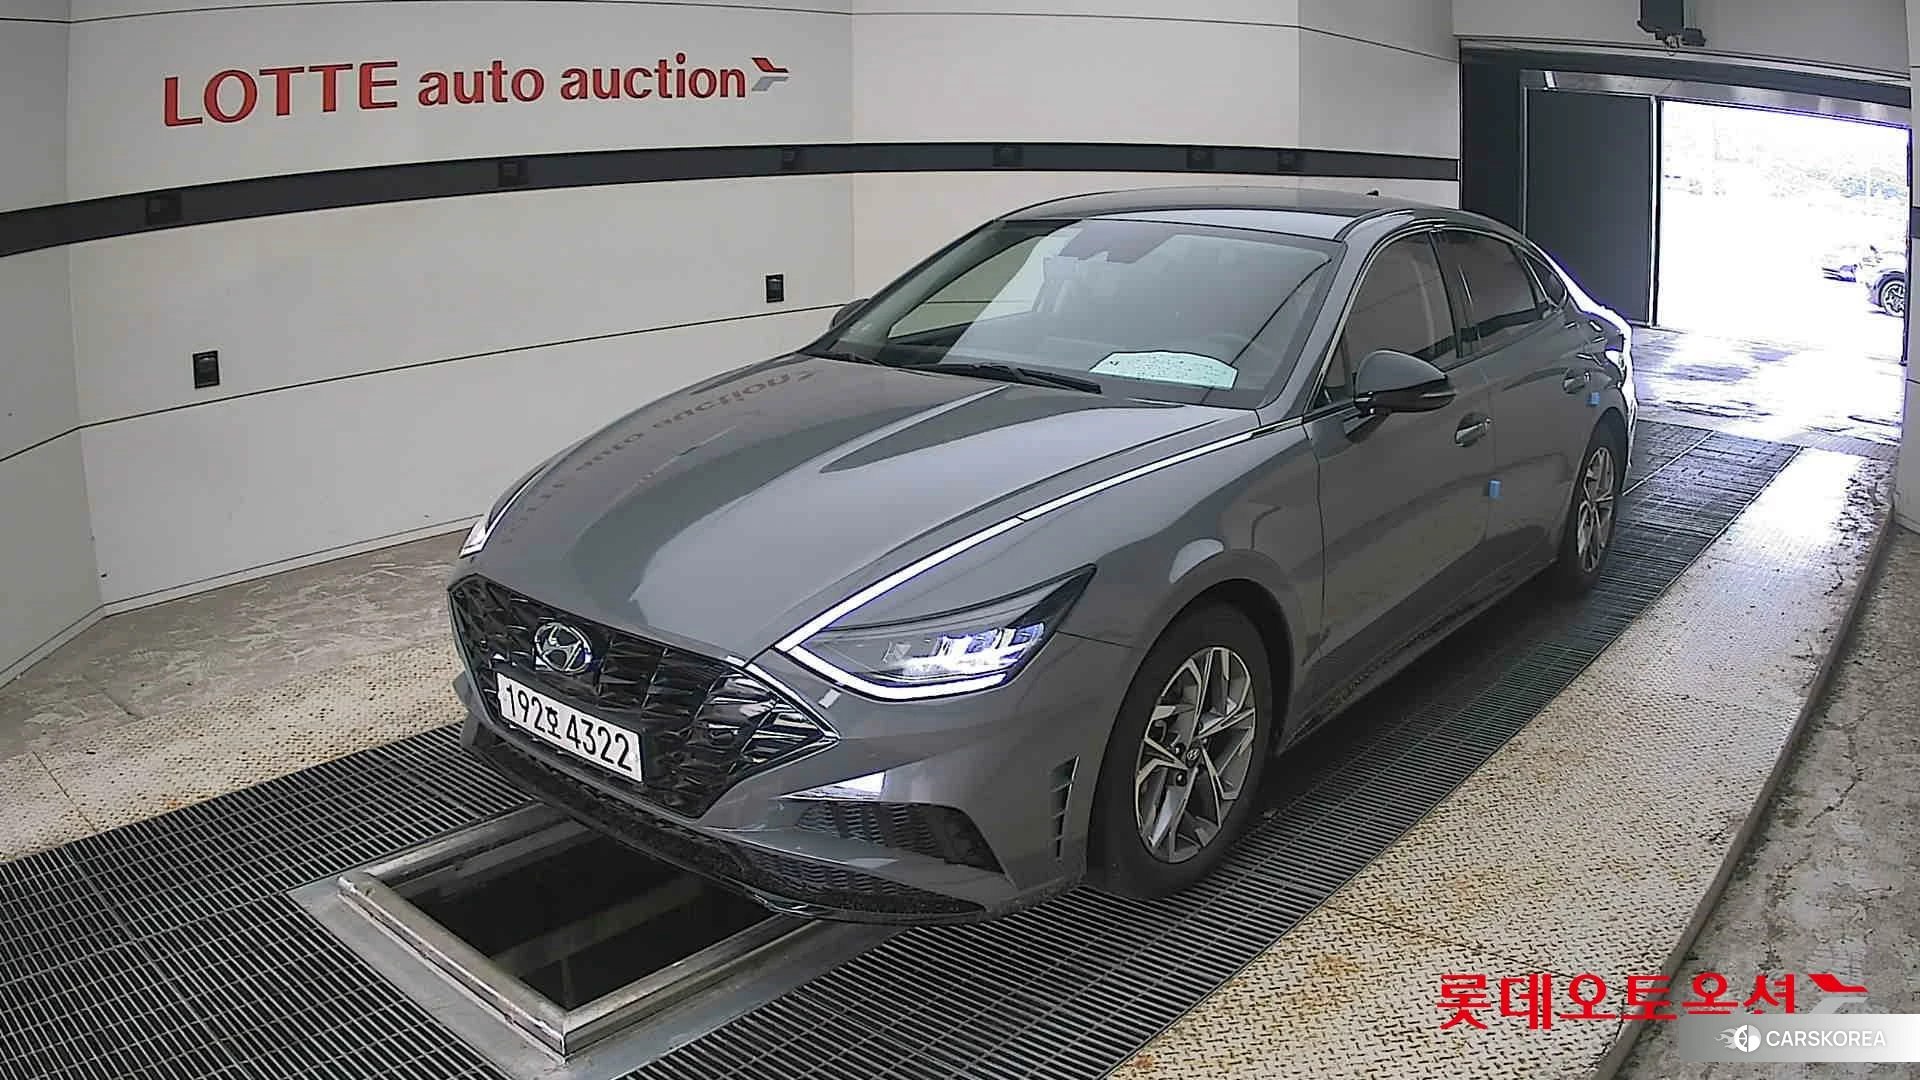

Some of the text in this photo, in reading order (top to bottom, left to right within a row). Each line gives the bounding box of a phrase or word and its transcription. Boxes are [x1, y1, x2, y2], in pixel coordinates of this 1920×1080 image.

[162, 51, 747, 127] LOTTE auto auction
[565, 714, 633, 772] 4322
